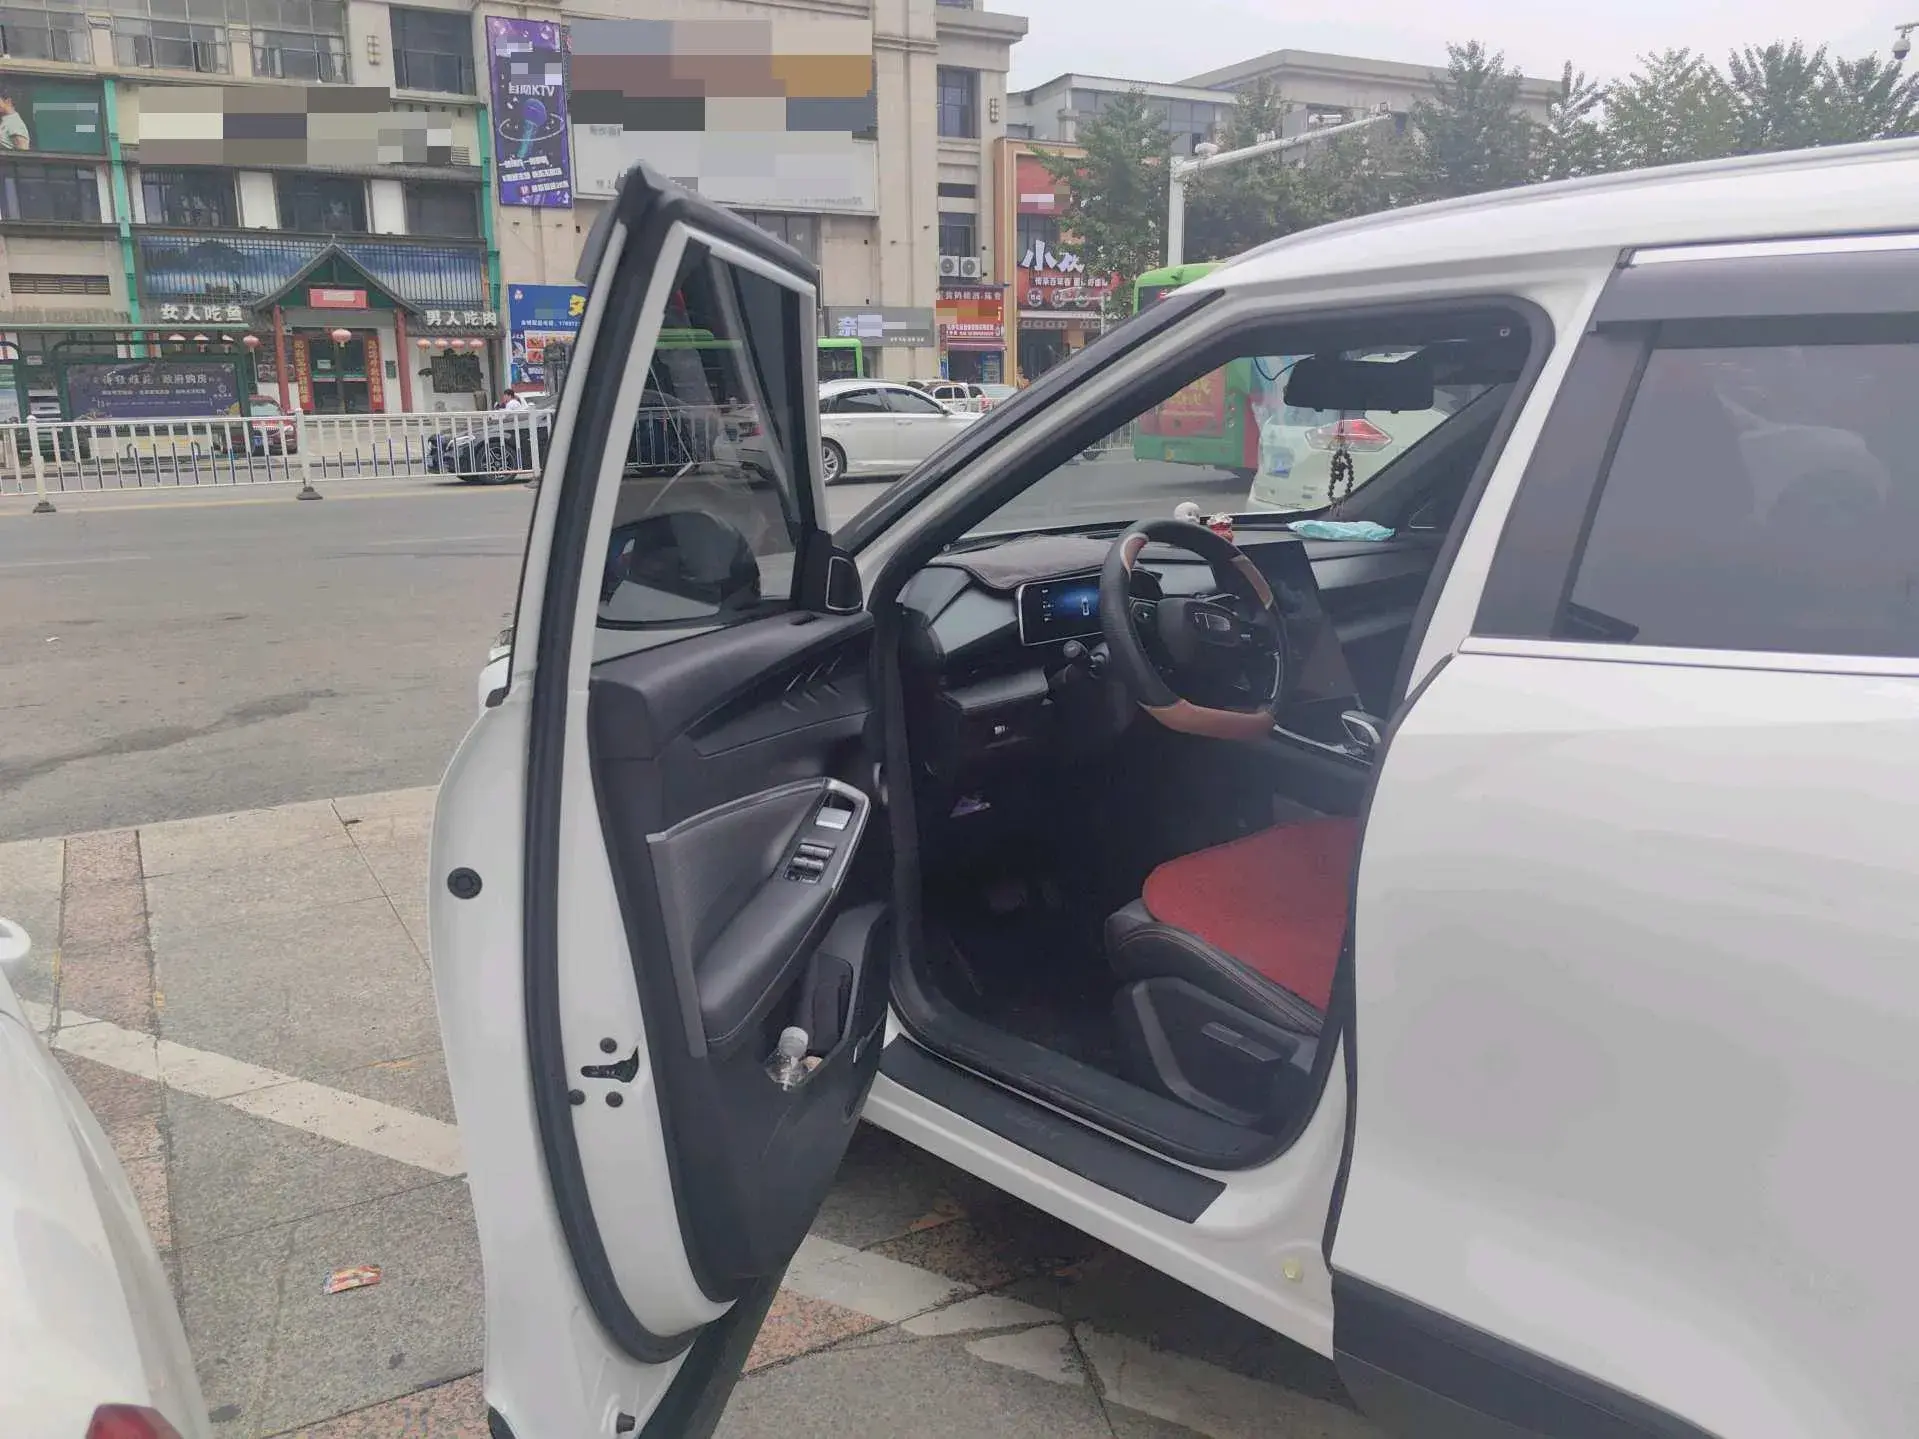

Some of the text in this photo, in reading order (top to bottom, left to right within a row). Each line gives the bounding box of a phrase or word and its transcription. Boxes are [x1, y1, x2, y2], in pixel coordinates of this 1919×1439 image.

[160, 303, 244, 321] 女人吃鱼
[426, 310, 497, 327] 男人吃肉
